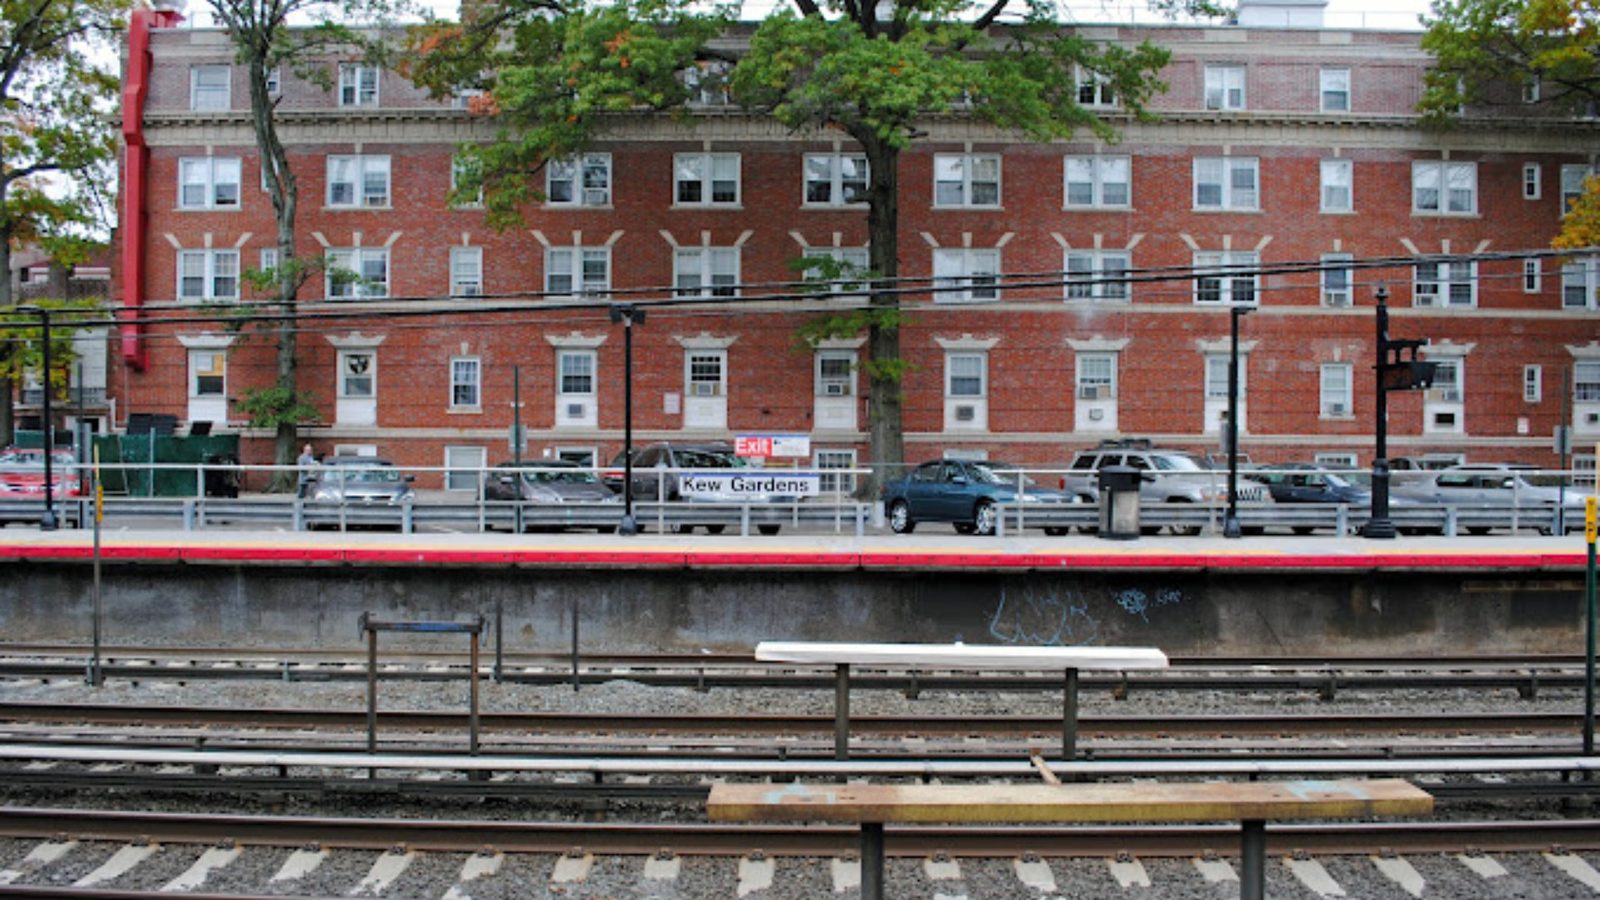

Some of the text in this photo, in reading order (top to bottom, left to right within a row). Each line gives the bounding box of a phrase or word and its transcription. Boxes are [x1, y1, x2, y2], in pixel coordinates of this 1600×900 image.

[736, 437, 769, 455] Exit
[683, 476, 809, 492] Kew Gardens
